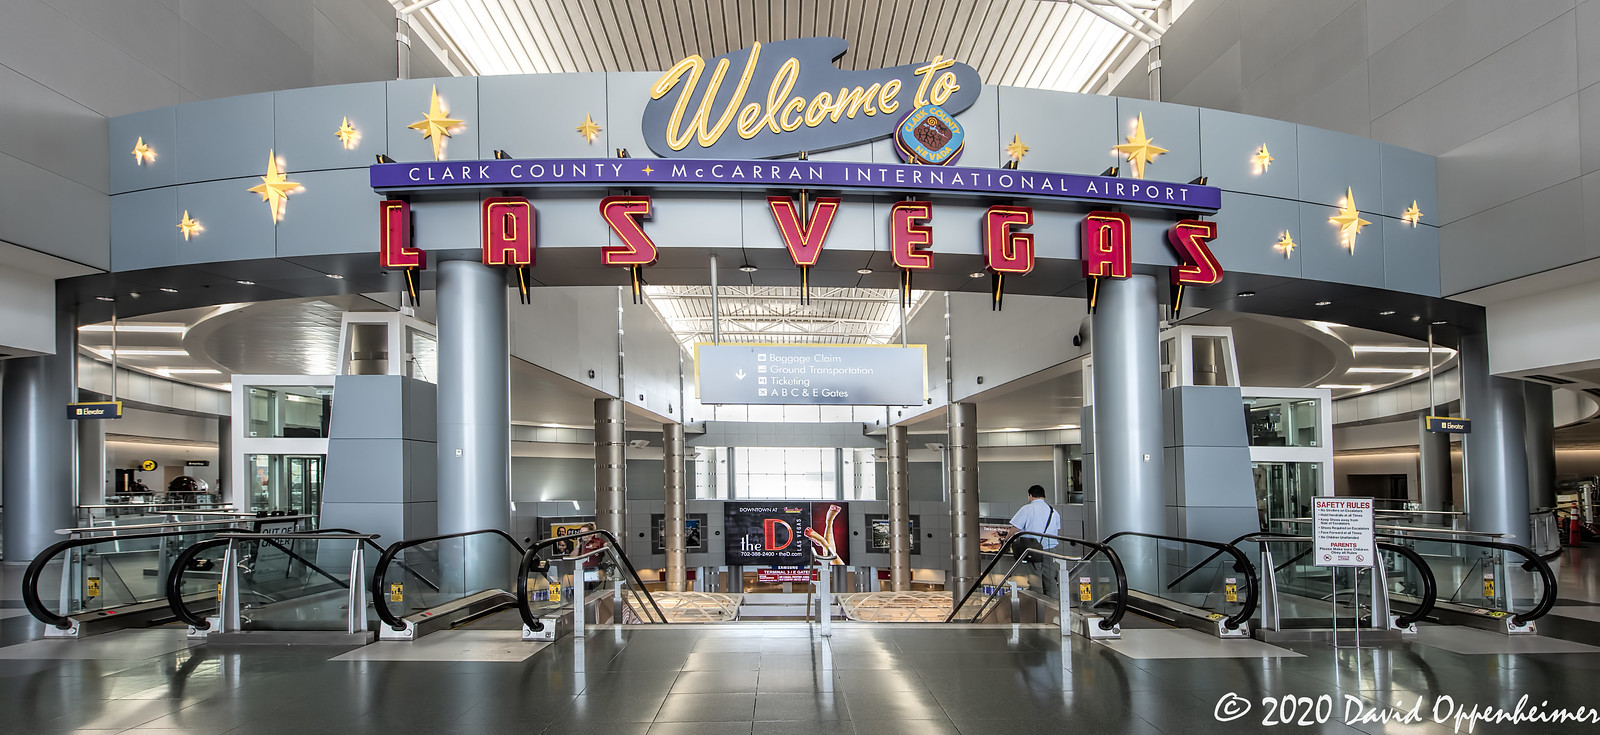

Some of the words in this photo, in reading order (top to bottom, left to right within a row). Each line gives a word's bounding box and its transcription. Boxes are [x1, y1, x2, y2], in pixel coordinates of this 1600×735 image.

[650, 41, 902, 150] Welcome
[914, 55, 960, 109] to
[905, 108, 928, 132] CLARK
[930, 108, 960, 134] COUNTY
[916, 146, 952, 160] NEVADA
[408, 165, 490, 182] CLARK
[510, 164, 624, 179] COUNTY
[672, 164, 823, 181] McCARRAN
[846, 168, 1068, 192] INTERNATIONAL
[1087, 181, 1188, 202] AIRPORT
[380, 196, 658, 270] LAS
[766, 197, 1223, 286] VEGAS
[770, 354, 810, 364] Baggage
[814, 354, 841, 362] Claim
[770, 365, 805, 374] Ground
[809, 366, 874, 375] Transportation
[771, 377, 810, 387] Ticketing
[822, 389, 848, 397] Gates
[741, 534, 761, 551] the
[764, 519, 793, 550] D
